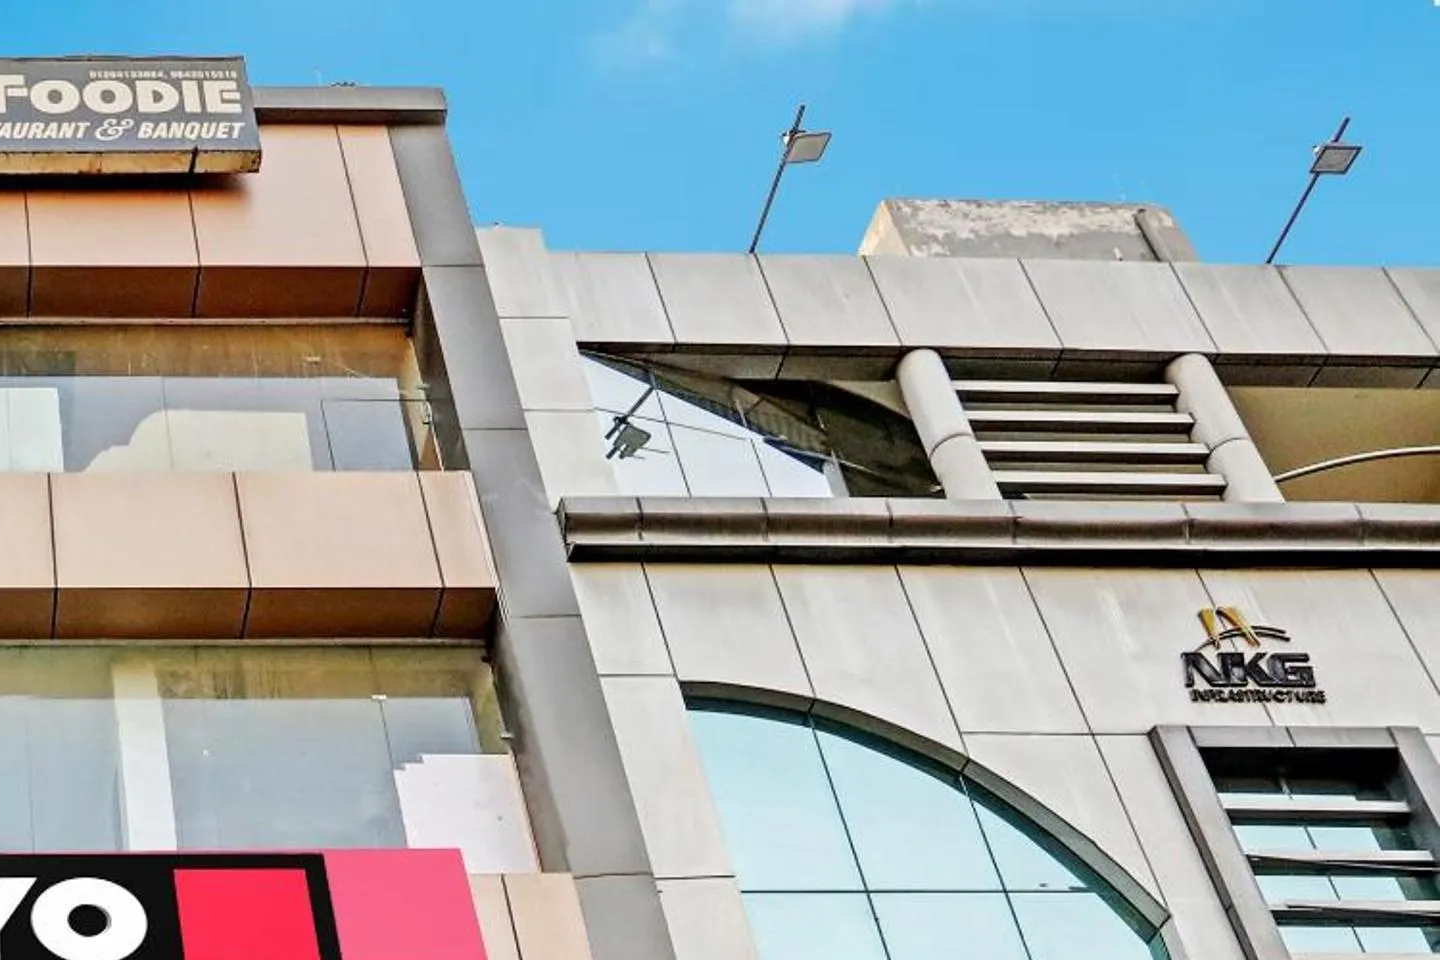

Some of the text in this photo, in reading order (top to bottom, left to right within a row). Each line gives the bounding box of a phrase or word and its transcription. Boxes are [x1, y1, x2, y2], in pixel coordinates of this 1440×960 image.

[95, 118, 134, 141] &
[138, 121, 246, 141] BANQUET
[1180, 652, 1316, 688] NKG
